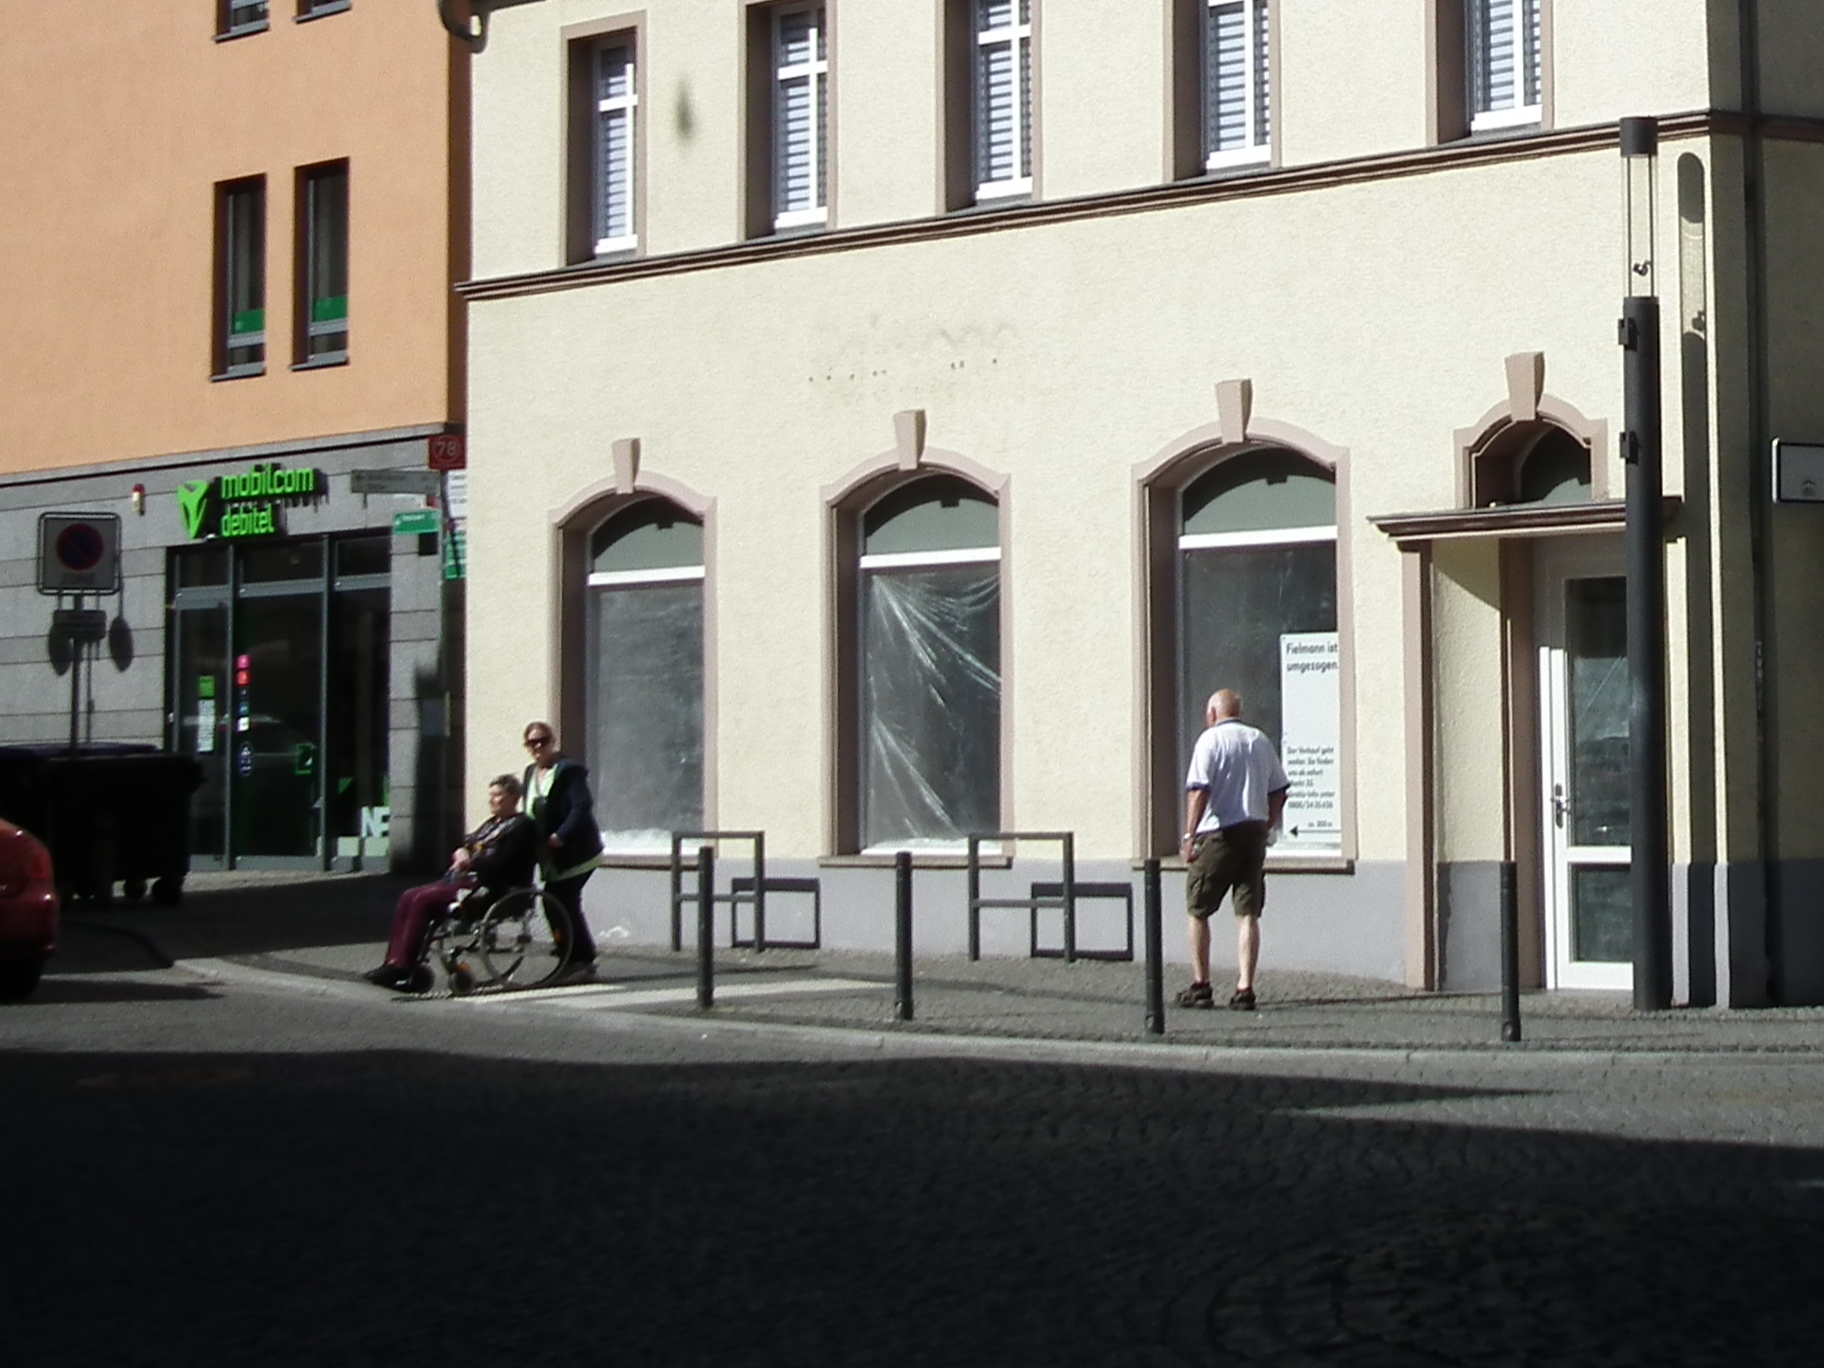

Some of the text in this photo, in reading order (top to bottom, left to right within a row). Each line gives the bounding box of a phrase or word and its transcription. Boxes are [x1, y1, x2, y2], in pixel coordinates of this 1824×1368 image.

[437, 441, 457, 454] 78
[222, 463, 314, 500] mobilcom
[221, 504, 275, 537] debitel
[1286, 642, 1325, 654] Fielmann
